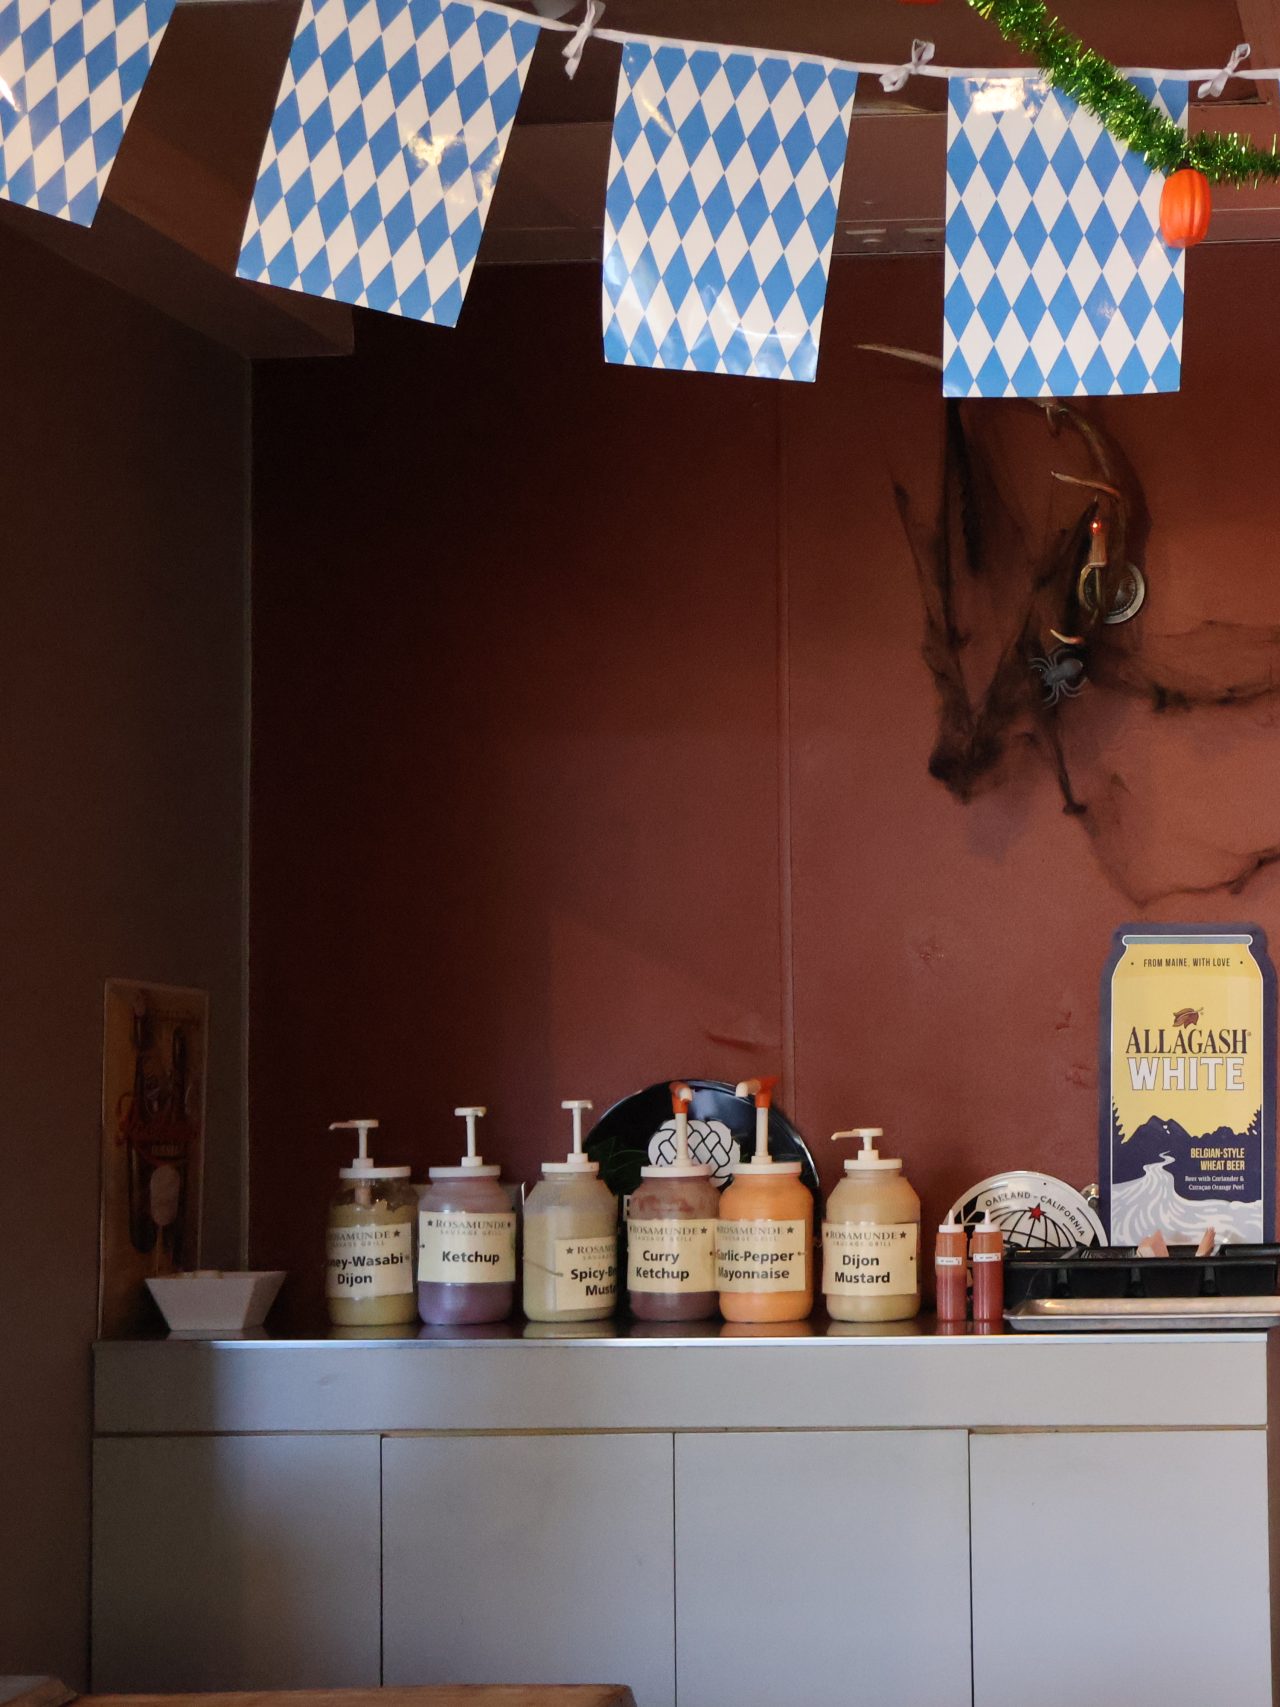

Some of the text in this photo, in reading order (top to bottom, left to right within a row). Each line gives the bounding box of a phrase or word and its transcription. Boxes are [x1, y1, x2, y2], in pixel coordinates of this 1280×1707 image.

[1143, 958, 1231, 968] FROM MAINE, WITH LOVE
[1126, 1056, 1245, 1091] WHITE
[1190, 1147, 1245, 1159] BELGIAN-STYLE
[1200, 1159, 1245, 1171] WHEAT BEER
[1211, 1184, 1232, 1192] Orange
[985, 1191, 1031, 1208] OAKLAND
[1039, 1195, 1086, 1238] CALIFORNIA
[435, 1219, 507, 1229] ROSAMUNDE
[632, 1224, 699, 1235] ROSAMUNDE
[829, 1230, 898, 1240] ROSAMUNDE
[442, 1251, 500, 1266] Ketchup
[642, 1250, 680, 1265] Curry
[842, 1254, 880, 1269] Dijon
[337, 1273, 373, 1287] Dijon
[635, 1266, 690, 1282] Ketchup
[718, 1266, 790, 1282] Mayonnaise
[834, 1271, 891, 1284] Mustard
